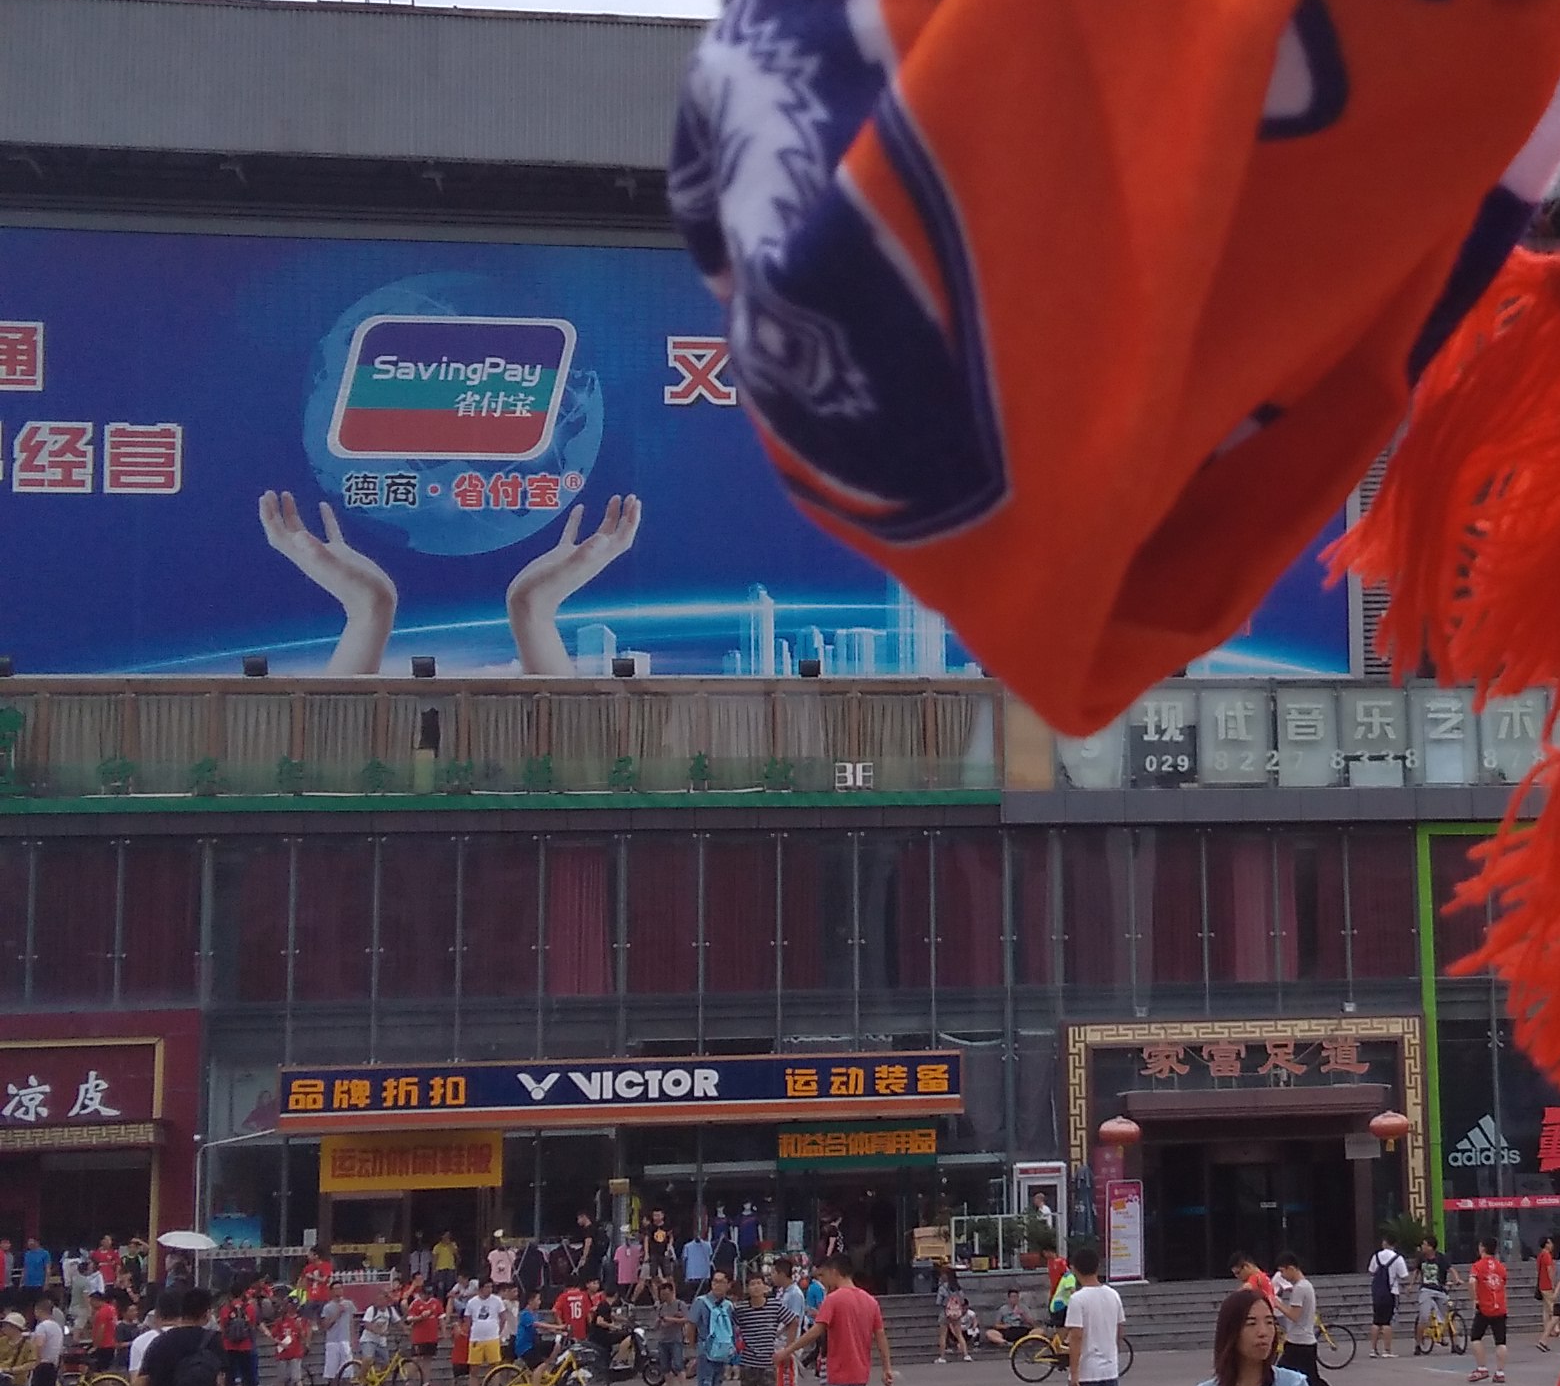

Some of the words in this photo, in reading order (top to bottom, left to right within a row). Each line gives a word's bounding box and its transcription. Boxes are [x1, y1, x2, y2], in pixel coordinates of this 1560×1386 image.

[373, 356, 542, 387] SavingPay
[454, 391, 535, 417] 省付宝
[13, 422, 182, 493] 经营
[1144, 754, 1189, 772] 029
[0, 1070, 121, 1122] 凉皮
[288, 1076, 466, 1111] 品牌折扣
[568, 1069, 719, 1100] VICTOR
[784, 1064, 949, 1098] 运动装备
[569, 1301, 582, 1319] 16
